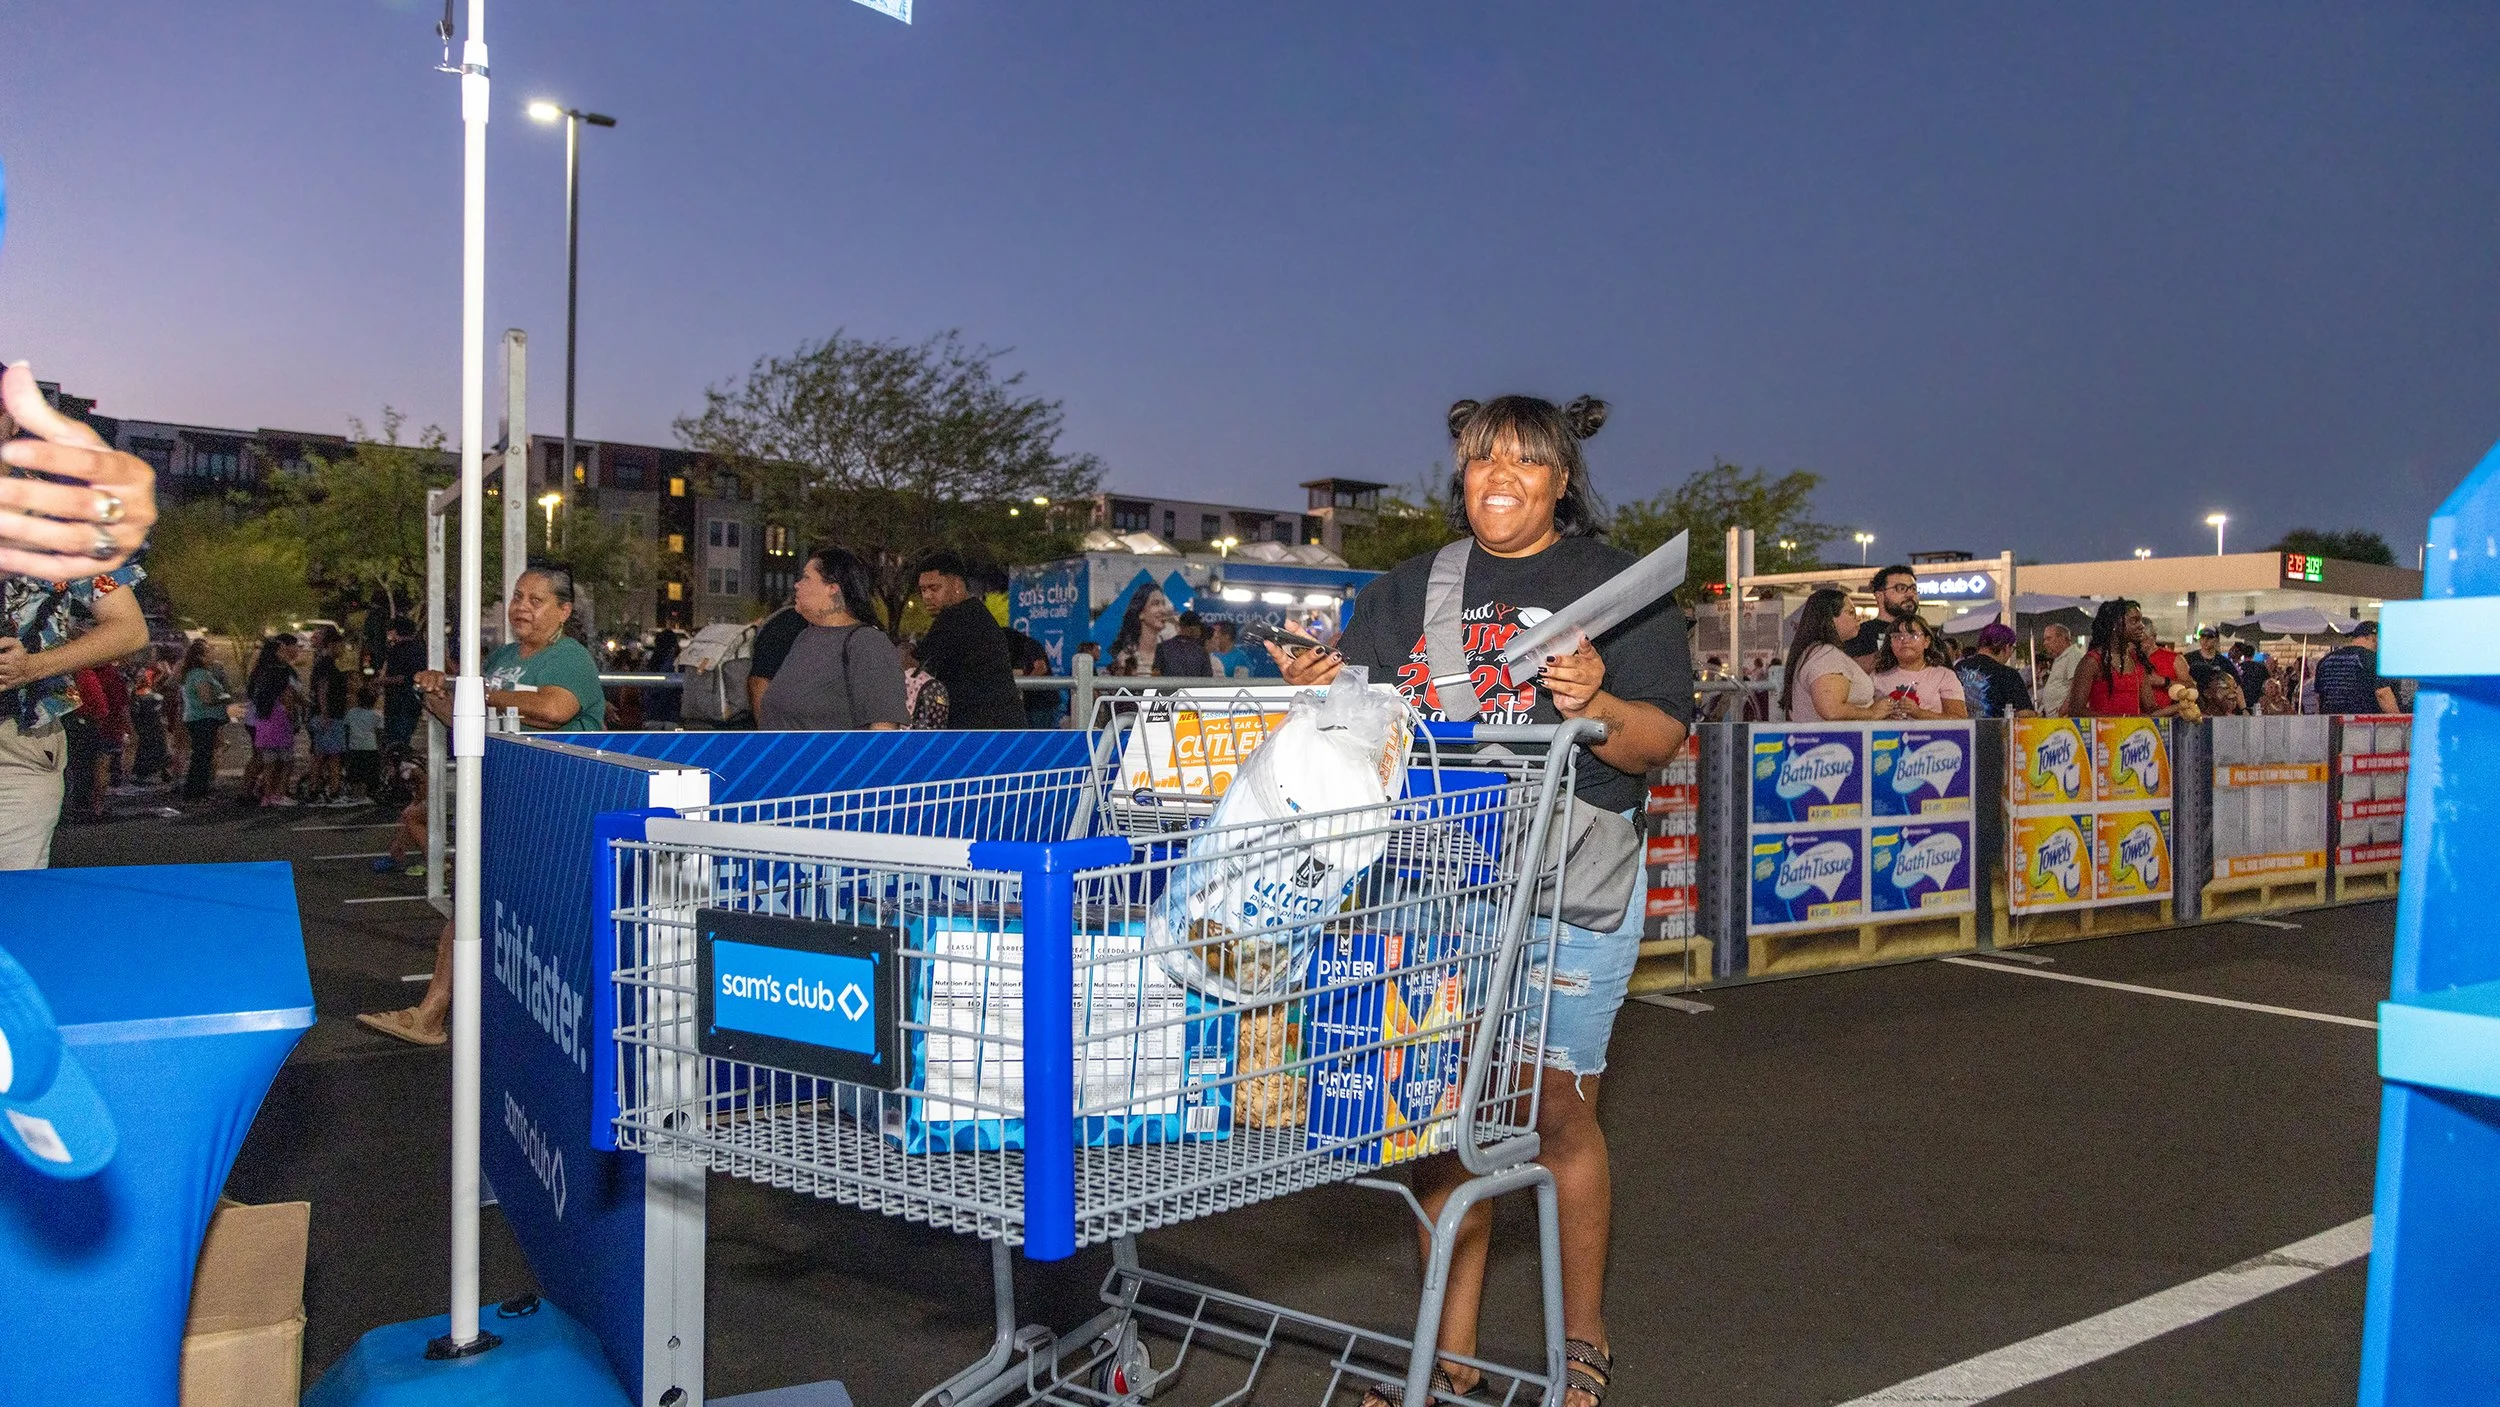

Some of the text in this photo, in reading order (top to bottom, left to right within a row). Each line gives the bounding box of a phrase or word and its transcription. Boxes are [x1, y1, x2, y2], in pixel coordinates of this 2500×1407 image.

[1047, 581, 1079, 604] club
[1940, 578, 1968, 593] club
[1397, 662, 1537, 714] 225
[1223, 720, 1252, 731] CEAR
[1176, 731, 1268, 759] CUTLE
[2038, 737, 2071, 776] Towels
[2120, 736, 2151, 774] Towels
[1781, 758, 1852, 787] Bath Tissue
[1896, 755, 1960, 781] Bath Tissue
[1896, 847, 1960, 877] Bath Tissue
[2038, 837, 2072, 877] Towels
[2121, 832, 2151, 870] Towels
[1780, 857, 1851, 887] Bath Tissue
[1253, 875, 1324, 915] ultra
[1320, 959, 1375, 977] DRYER
[495, 899, 587, 1074] Exit faster.
[721, 973, 834, 1012] sam's club
[1318, 1070, 1374, 1091] DRYER
[1326, 1087, 1363, 1101] SHEETS
[504, 1090, 551, 1191] sam's club
